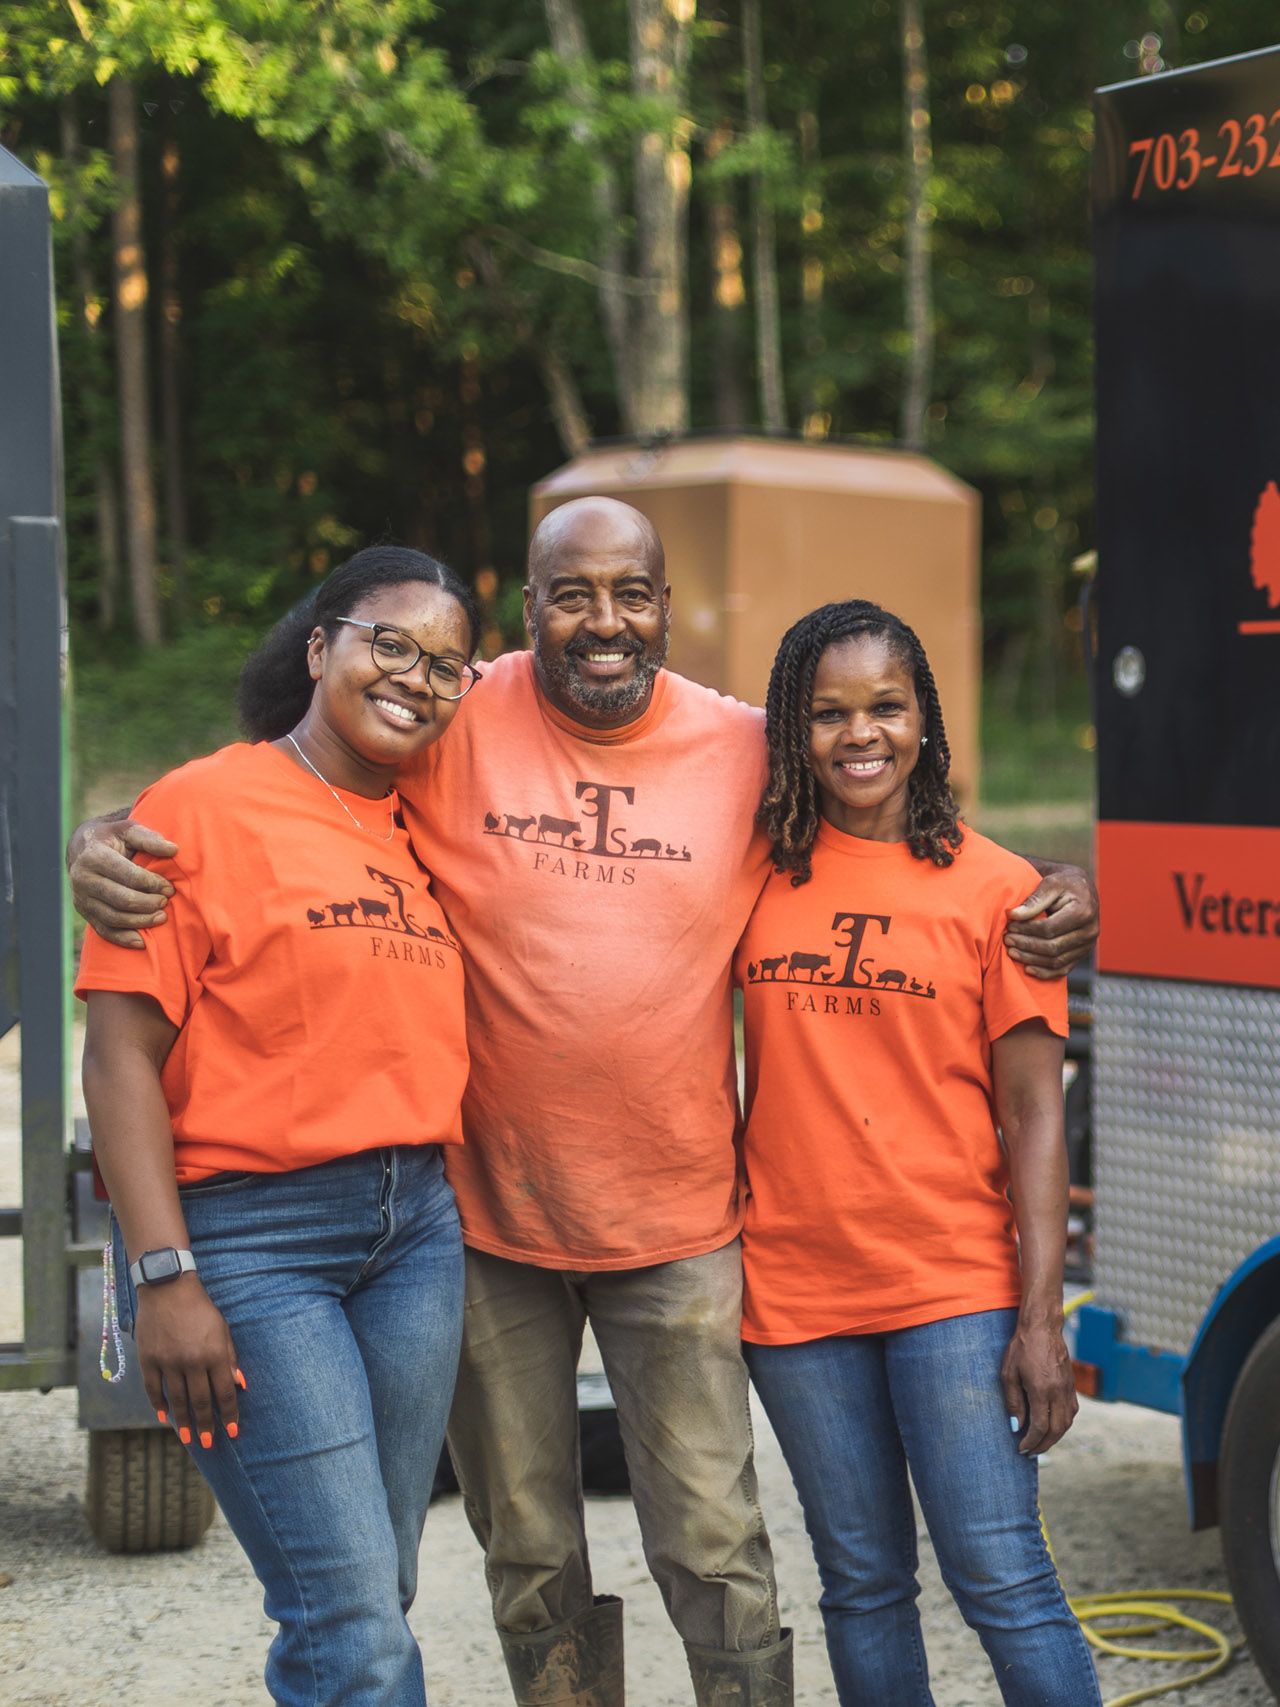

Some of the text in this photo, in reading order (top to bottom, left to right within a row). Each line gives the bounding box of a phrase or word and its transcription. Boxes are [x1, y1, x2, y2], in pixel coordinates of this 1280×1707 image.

[532, 852, 636, 885] FARMS
[370, 936, 446, 970] FARMS
[786, 991, 881, 1016] FARMS
